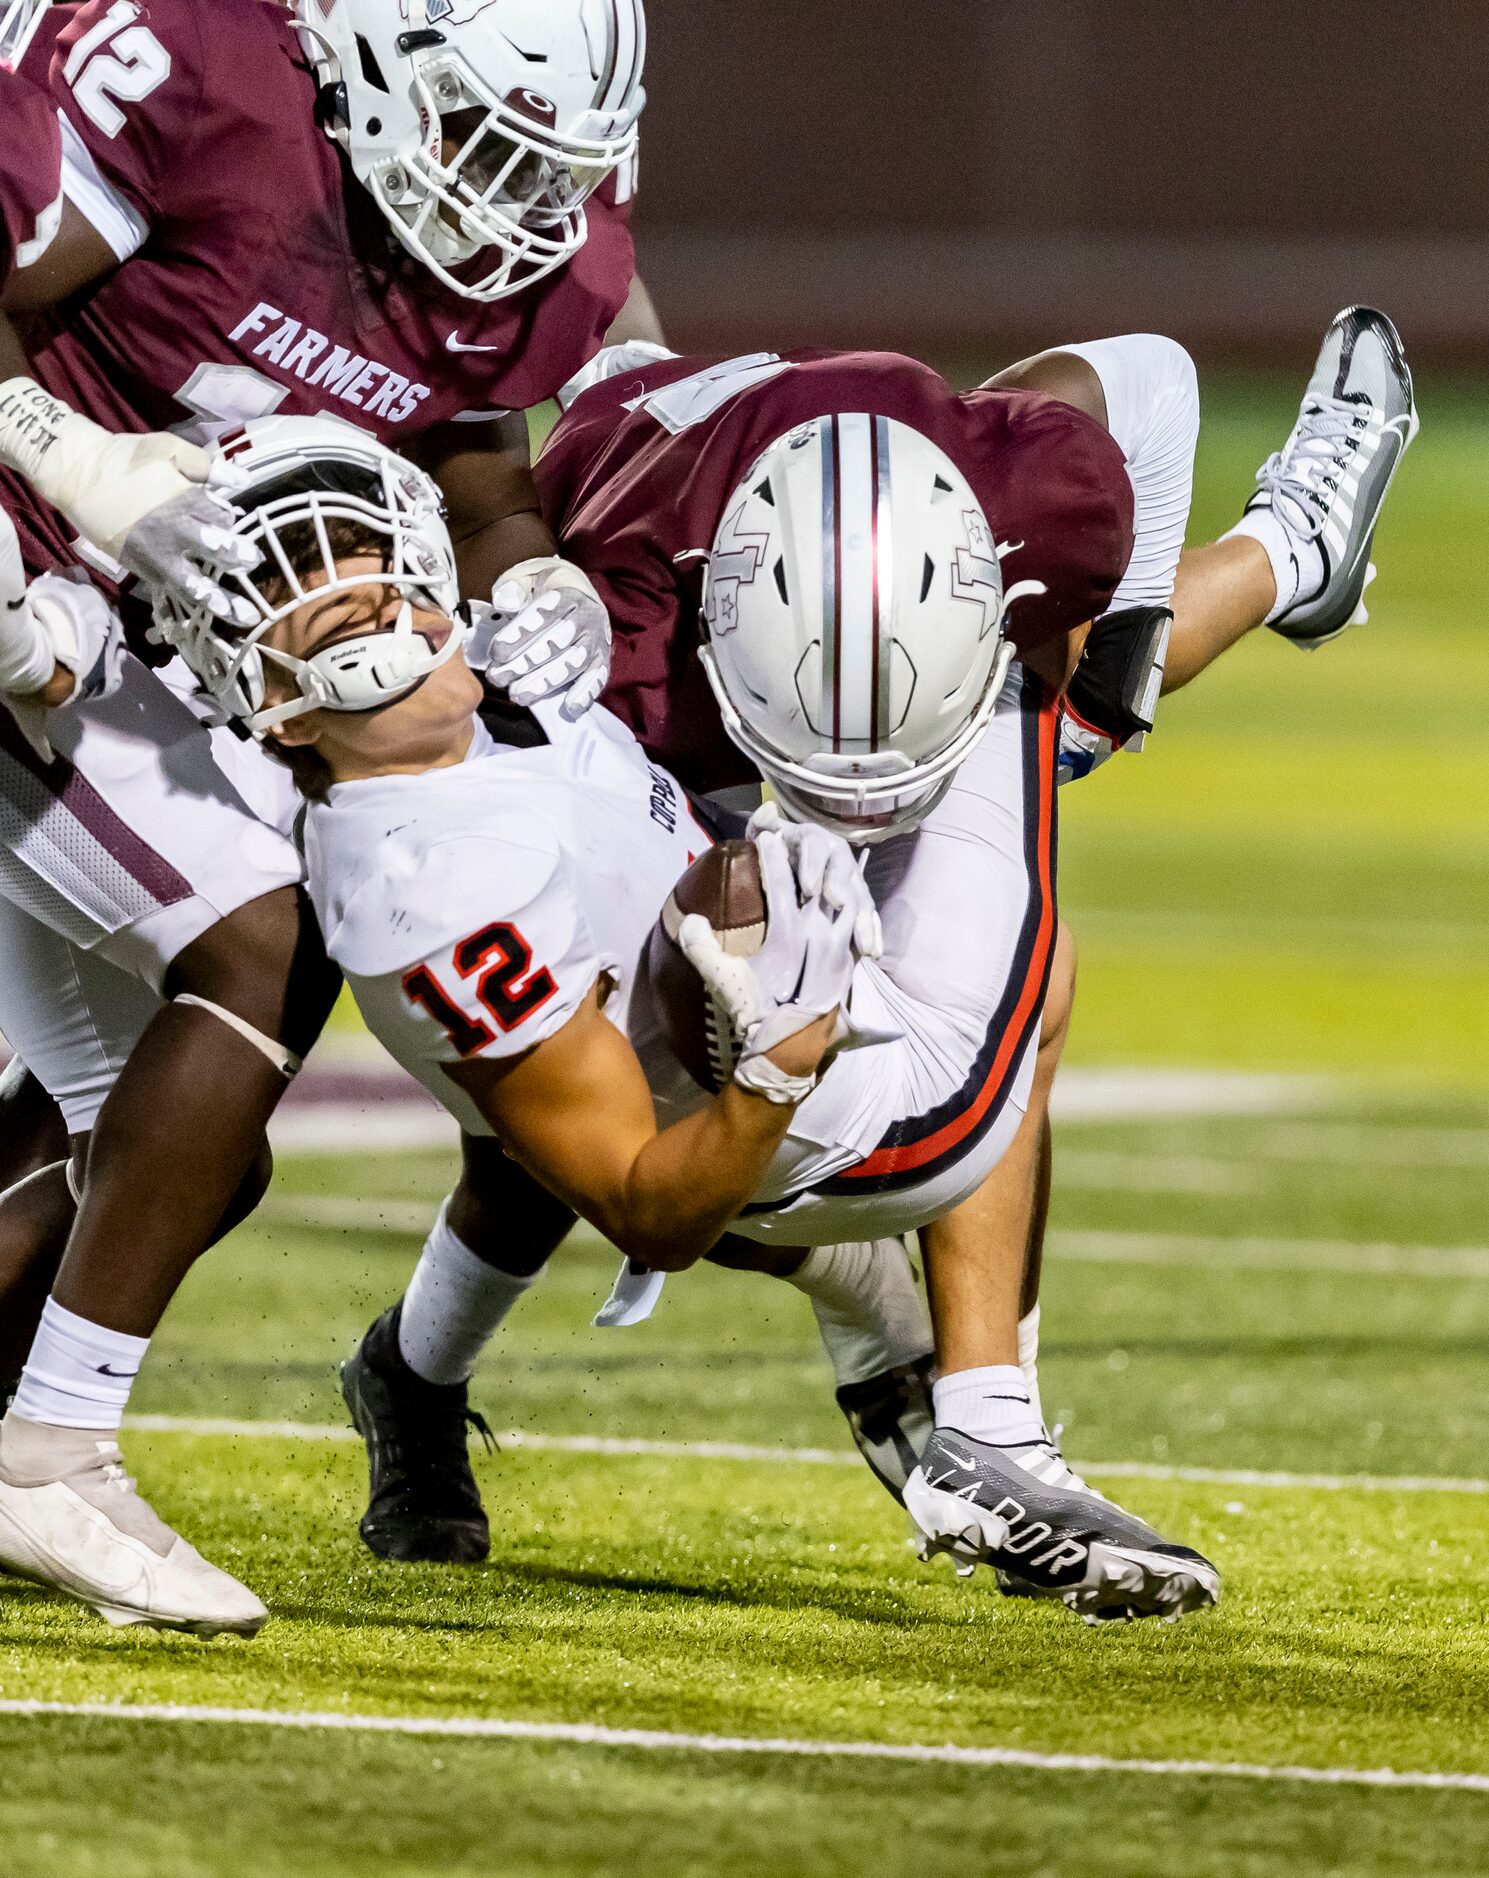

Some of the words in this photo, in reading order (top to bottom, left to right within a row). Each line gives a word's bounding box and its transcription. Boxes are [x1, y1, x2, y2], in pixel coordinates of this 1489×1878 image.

[62, 0, 172, 140] 12
[227, 301, 431, 423] FARMERS
[401, 920, 560, 1060] 12
